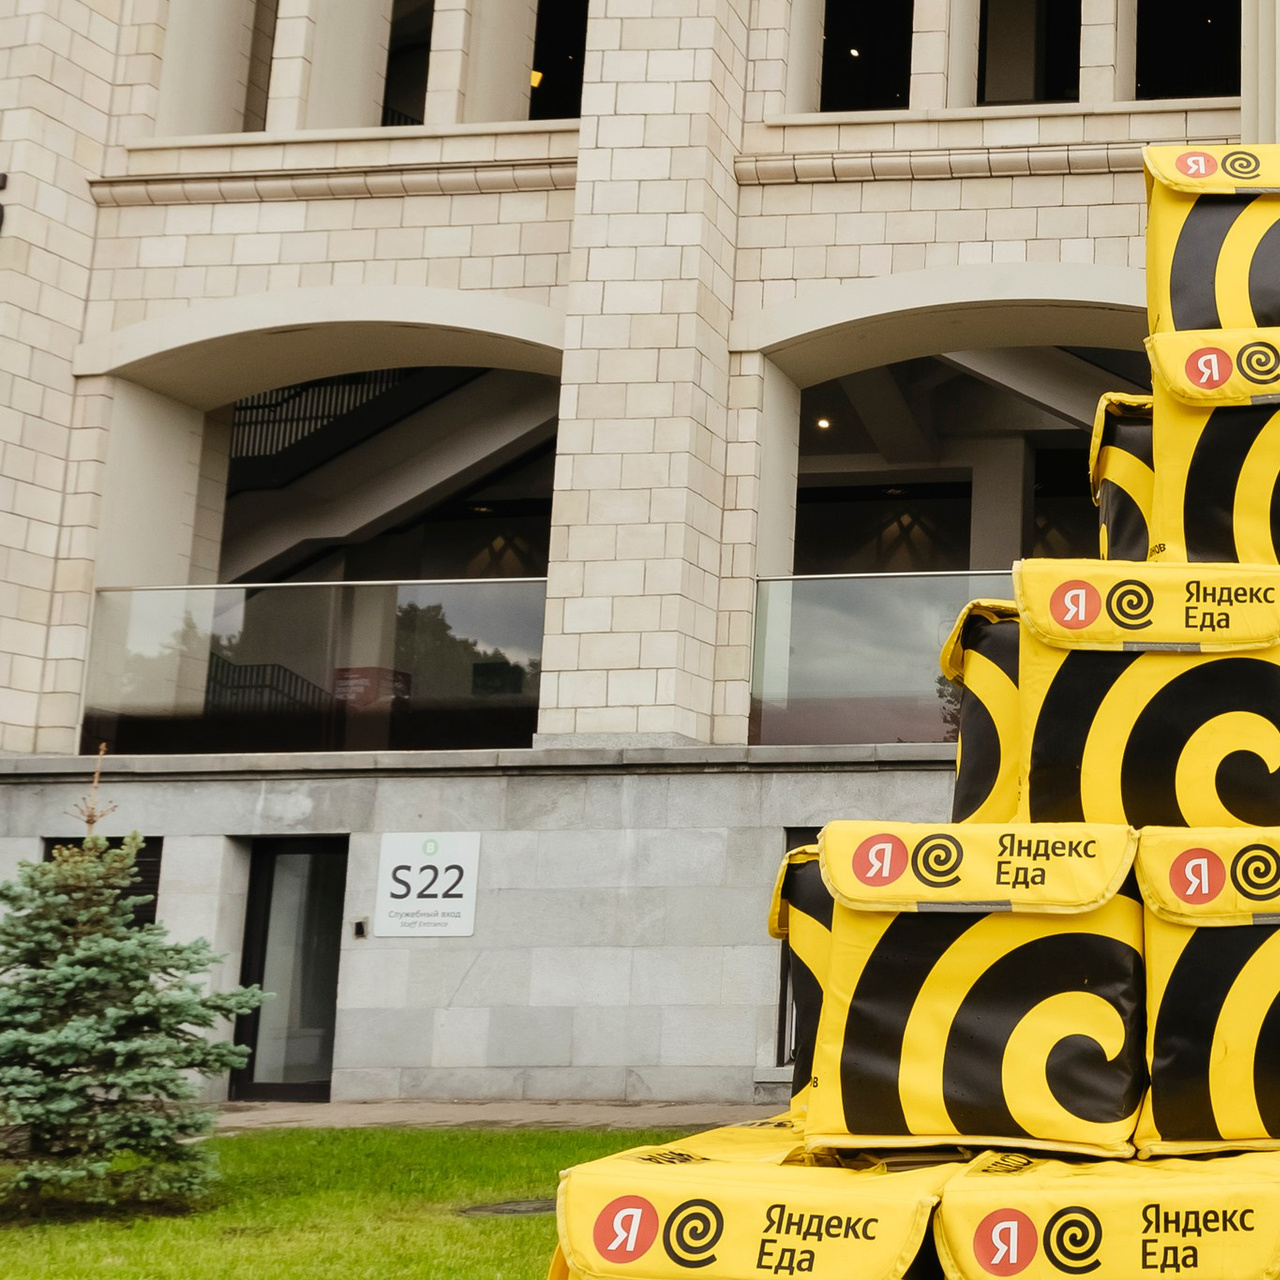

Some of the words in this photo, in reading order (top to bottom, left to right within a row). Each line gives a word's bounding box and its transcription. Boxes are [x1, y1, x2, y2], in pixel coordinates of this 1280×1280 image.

[1185, 580, 1275, 607] Яндекс
[1185, 606, 1230, 632] Еда
[997, 833, 1096, 861] Яндекс
[390, 864, 464, 900] S22
[996, 860, 1046, 889] Еда
[388, 909, 439, 920] Служебный
[440, 910, 461, 919] вход
[400, 920, 418, 929] Staff
[418, 920, 448, 928] Entrance
[762, 1203, 879, 1242] Яндекс
[1141, 1203, 1255, 1238] Яндекс
[756, 1238, 815, 1276] Еда
[1141, 1238, 1198, 1274] Еда
